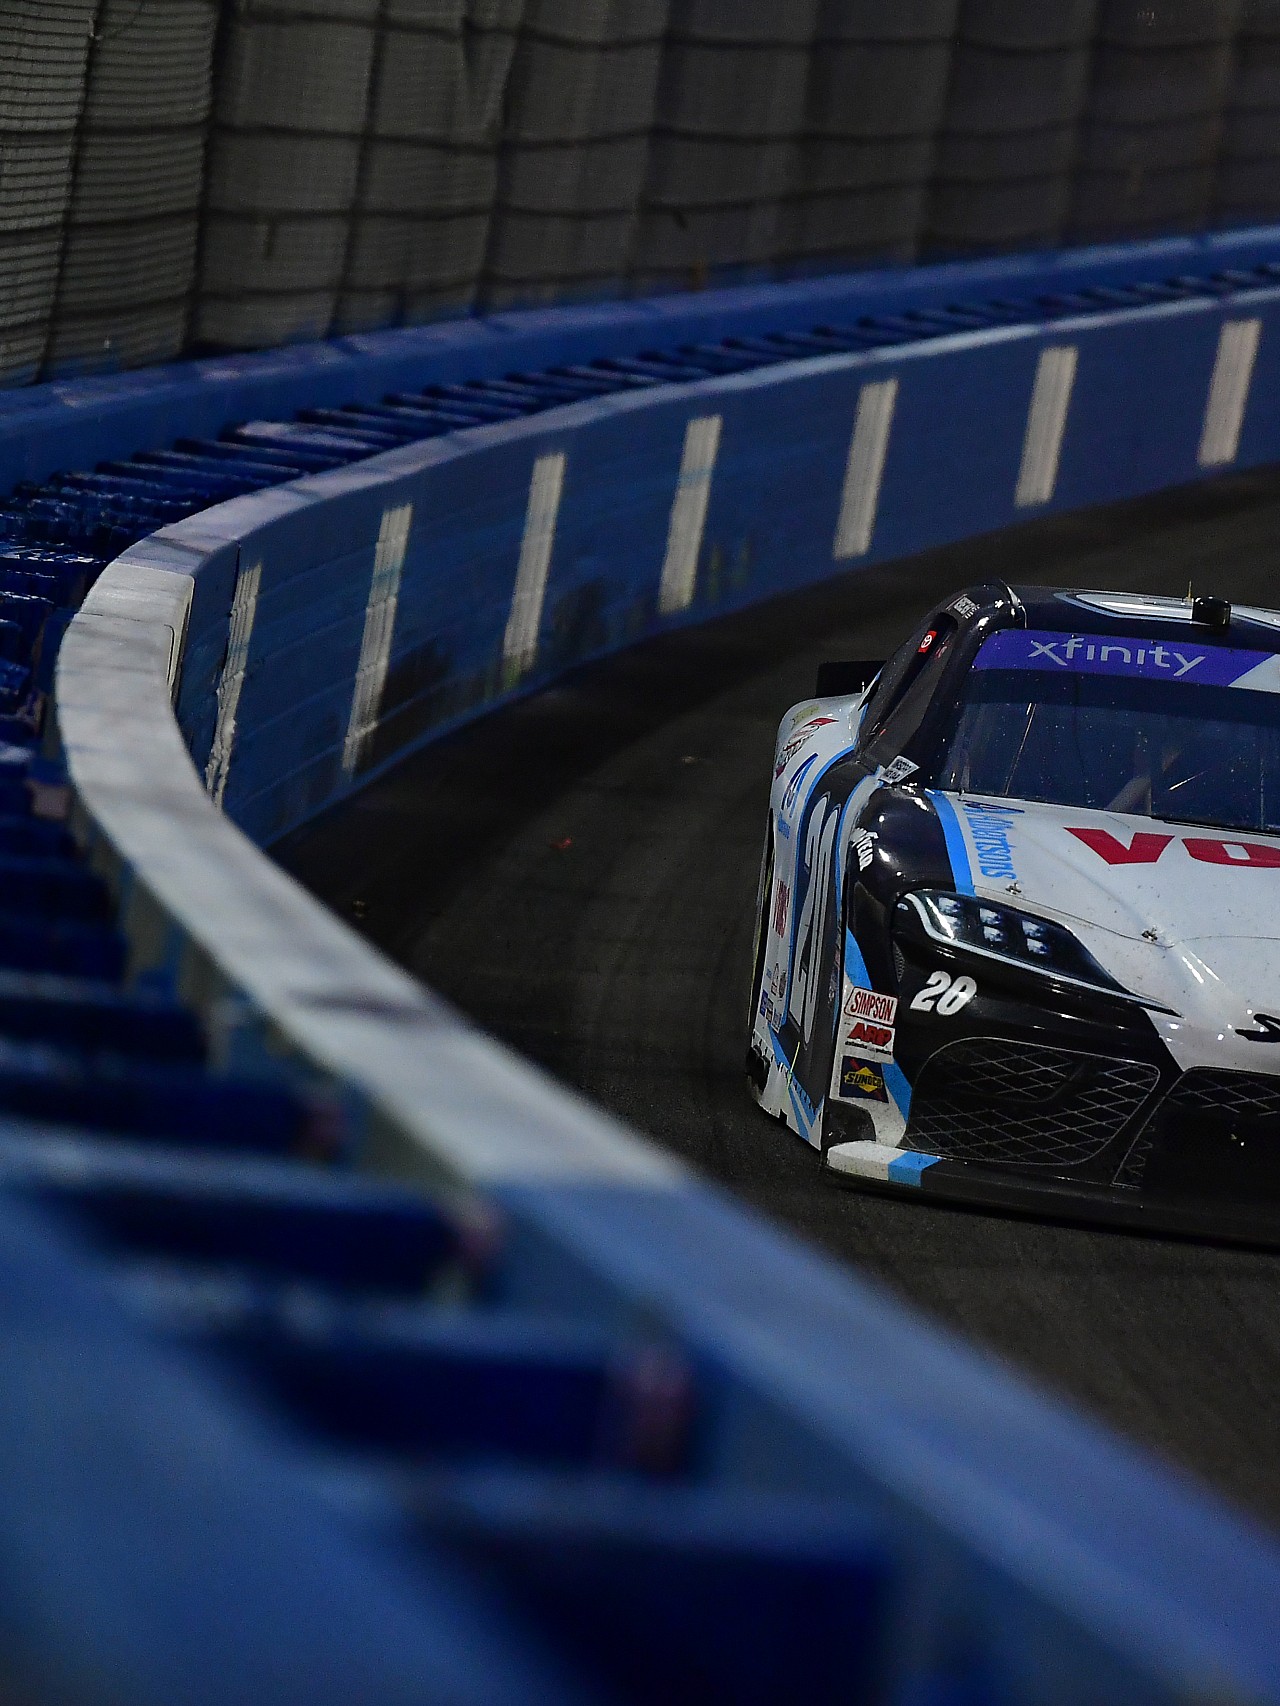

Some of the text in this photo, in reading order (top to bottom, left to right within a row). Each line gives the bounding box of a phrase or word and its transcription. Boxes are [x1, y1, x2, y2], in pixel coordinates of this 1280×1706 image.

[1028, 637, 1206, 677] xfinity
[851, 991, 893, 1021] SIMPSON
[910, 971, 977, 1016] 20
[843, 1071, 883, 1088] SUNOCO
